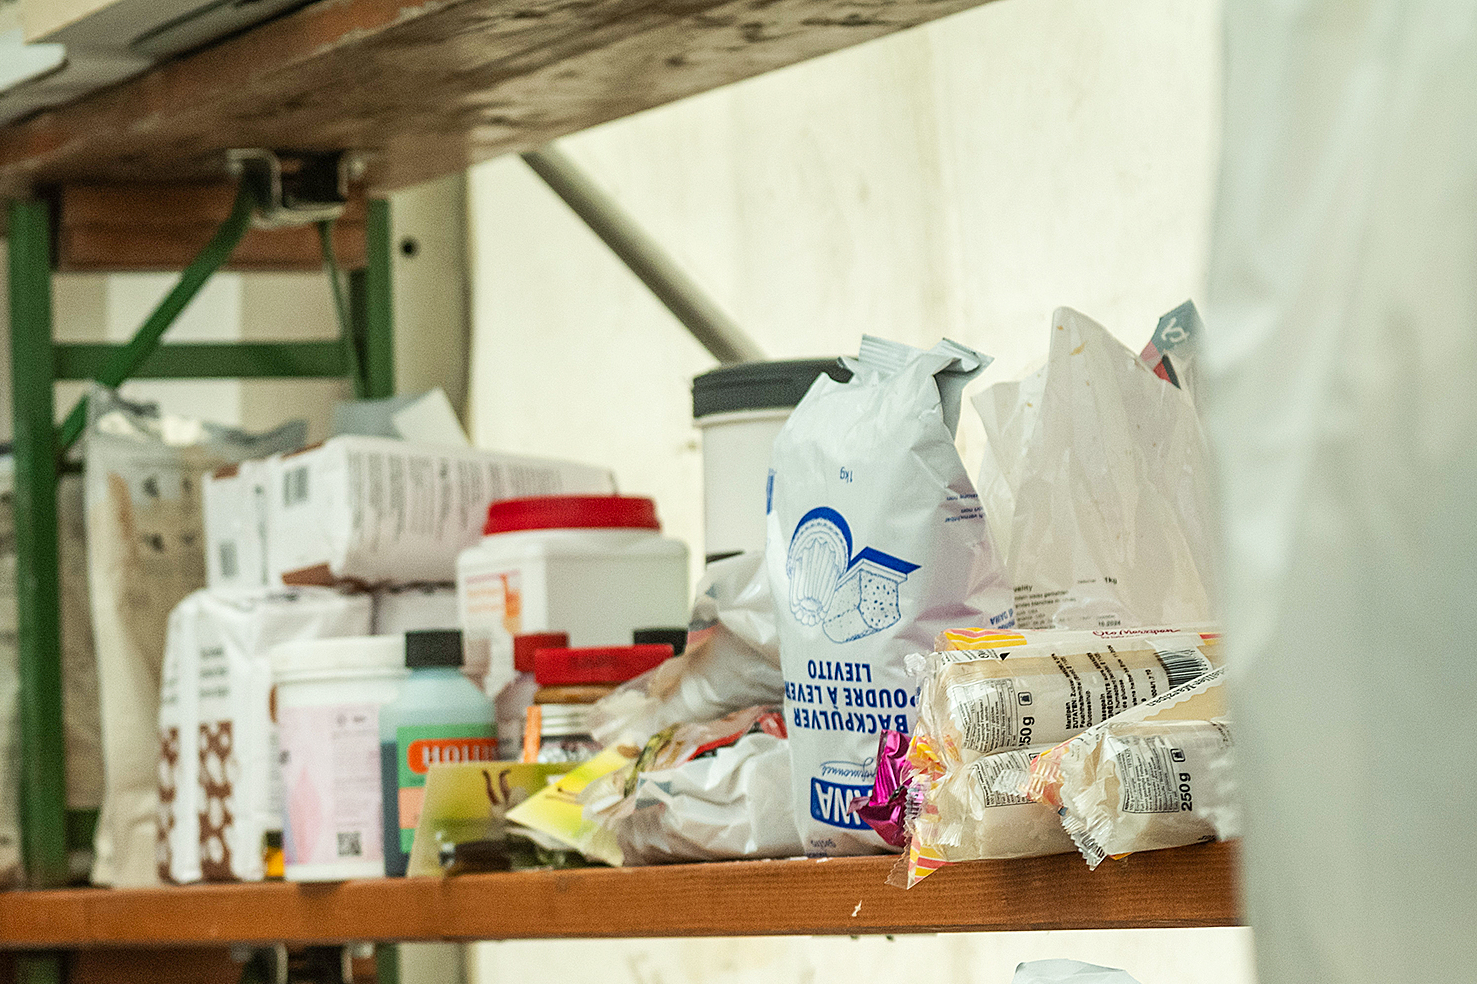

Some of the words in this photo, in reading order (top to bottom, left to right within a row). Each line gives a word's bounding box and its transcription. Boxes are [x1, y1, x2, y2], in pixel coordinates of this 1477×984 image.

[839, 466, 853, 483] 1kg
[807, 659, 872, 683] LIEVITO
[827, 686, 839, 711] À
[793, 707, 909, 734] BACKPULVER
